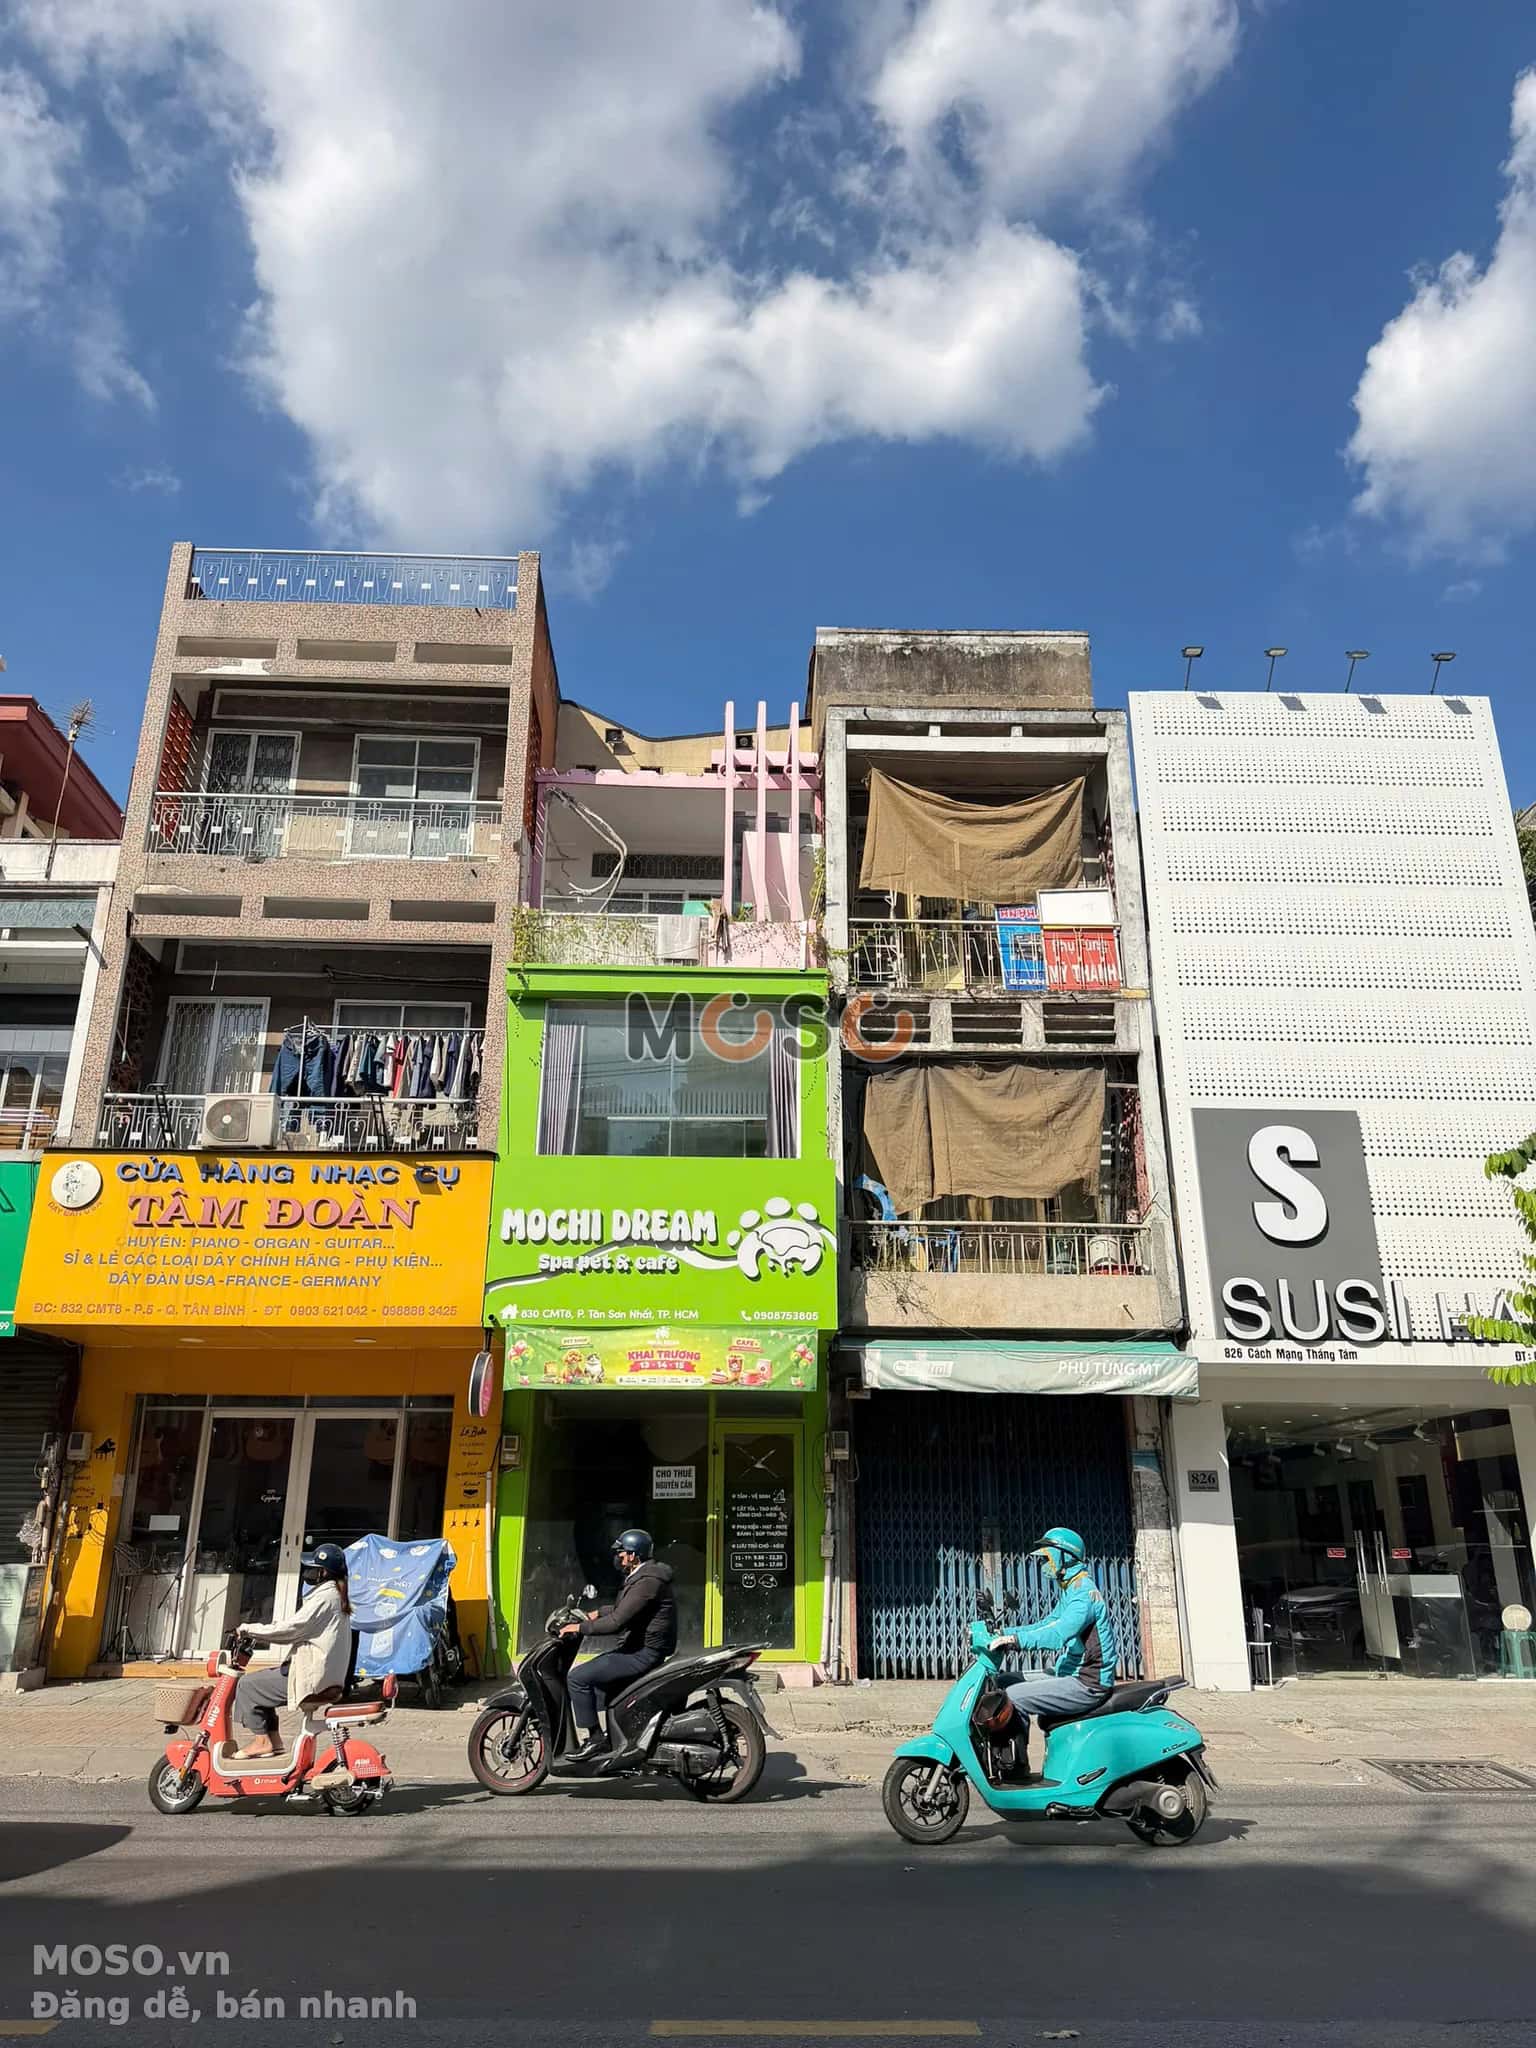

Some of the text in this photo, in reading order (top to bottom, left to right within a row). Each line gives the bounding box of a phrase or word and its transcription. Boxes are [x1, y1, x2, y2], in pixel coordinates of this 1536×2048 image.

[117, 1156, 460, 1191] CỬA HÀNG NHẠC CỤ
[1247, 1124, 1328, 1243] S
[128, 1187, 420, 1230] TÂM ĐOÀN
[501, 1208, 718, 1244] MOCHI DREAM
[191, 1237, 240, 1249] PIANO
[254, 1238, 310, 1249] ORGAN
[325, 1238, 395, 1250] GUITAR...
[83, 1253, 94, 1265] &
[124, 1252, 158, 1266] CÁC
[162, 1255, 199, 1268] LOẠI
[203, 1252, 236, 1267] DÂY
[241, 1253, 290, 1268] CHÍNH
[295, 1253, 341, 1267] HÃNG
[355, 1255, 388, 1270] PHỤ
[577, 1254, 612, 1275] pet
[615, 1254, 630, 1274] &
[635, 1253, 679, 1274] cafe
[109, 1271, 142, 1285] DÂY
[146, 1272, 179, 1285] ĐÀN
[184, 1275, 216, 1287] USA
[61, 1304, 82, 1313] 832
[166, 1305, 178, 1315] Q.
[183, 1303, 209, 1315] TÂN
[214, 1303, 246, 1315] BÌNH
[264, 1305, 283, 1316] ĐT
[290, 1306, 319, 1316] 0903
[428, 1306, 457, 1316] 3425
[577, 1309, 585, 1318] P.
[657, 1309, 671, 1319] TP.
[674, 1309, 699, 1319] HCM
[1222, 1277, 1411, 1342] SUSI
[628, 1350, 654, 1359] KHAI
[1224, 1347, 1358, 1362] 826 Cách Mạng Tháng Tám
[1191, 1473, 1216, 1484] 826
